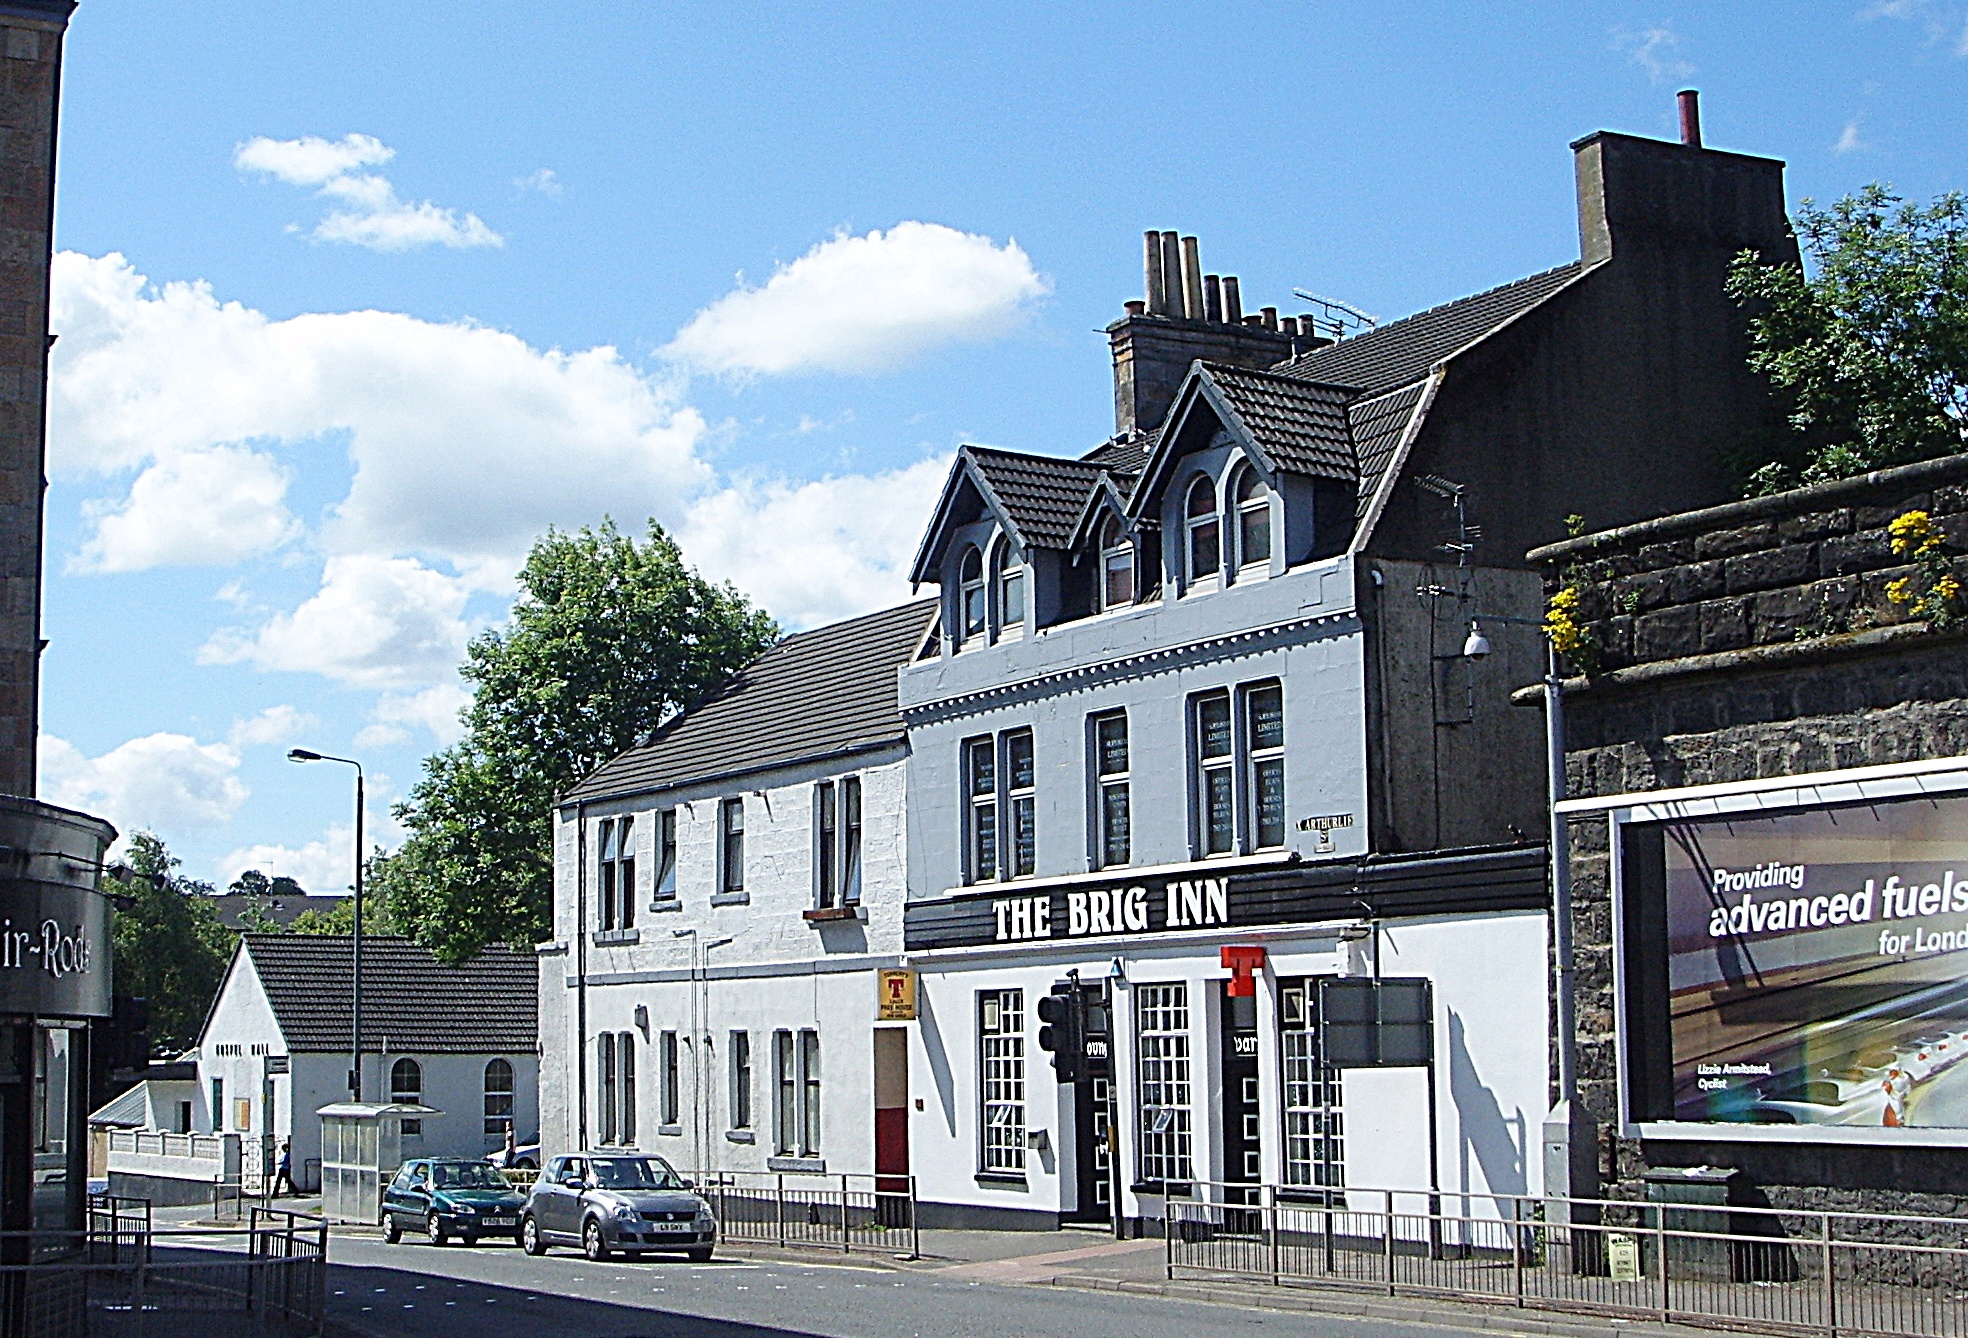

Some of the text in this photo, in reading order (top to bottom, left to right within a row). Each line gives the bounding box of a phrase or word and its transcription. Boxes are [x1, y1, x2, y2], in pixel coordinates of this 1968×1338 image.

[1713, 861, 1805, 893] Providing
[992, 877, 1229, 941] THE BRIG INN
[1709, 870, 1968, 938] advanced fuels
[1879, 929, 1910, 956] for
[888, 978, 905, 999] T
[1697, 1078, 1728, 1091] Cyclist
